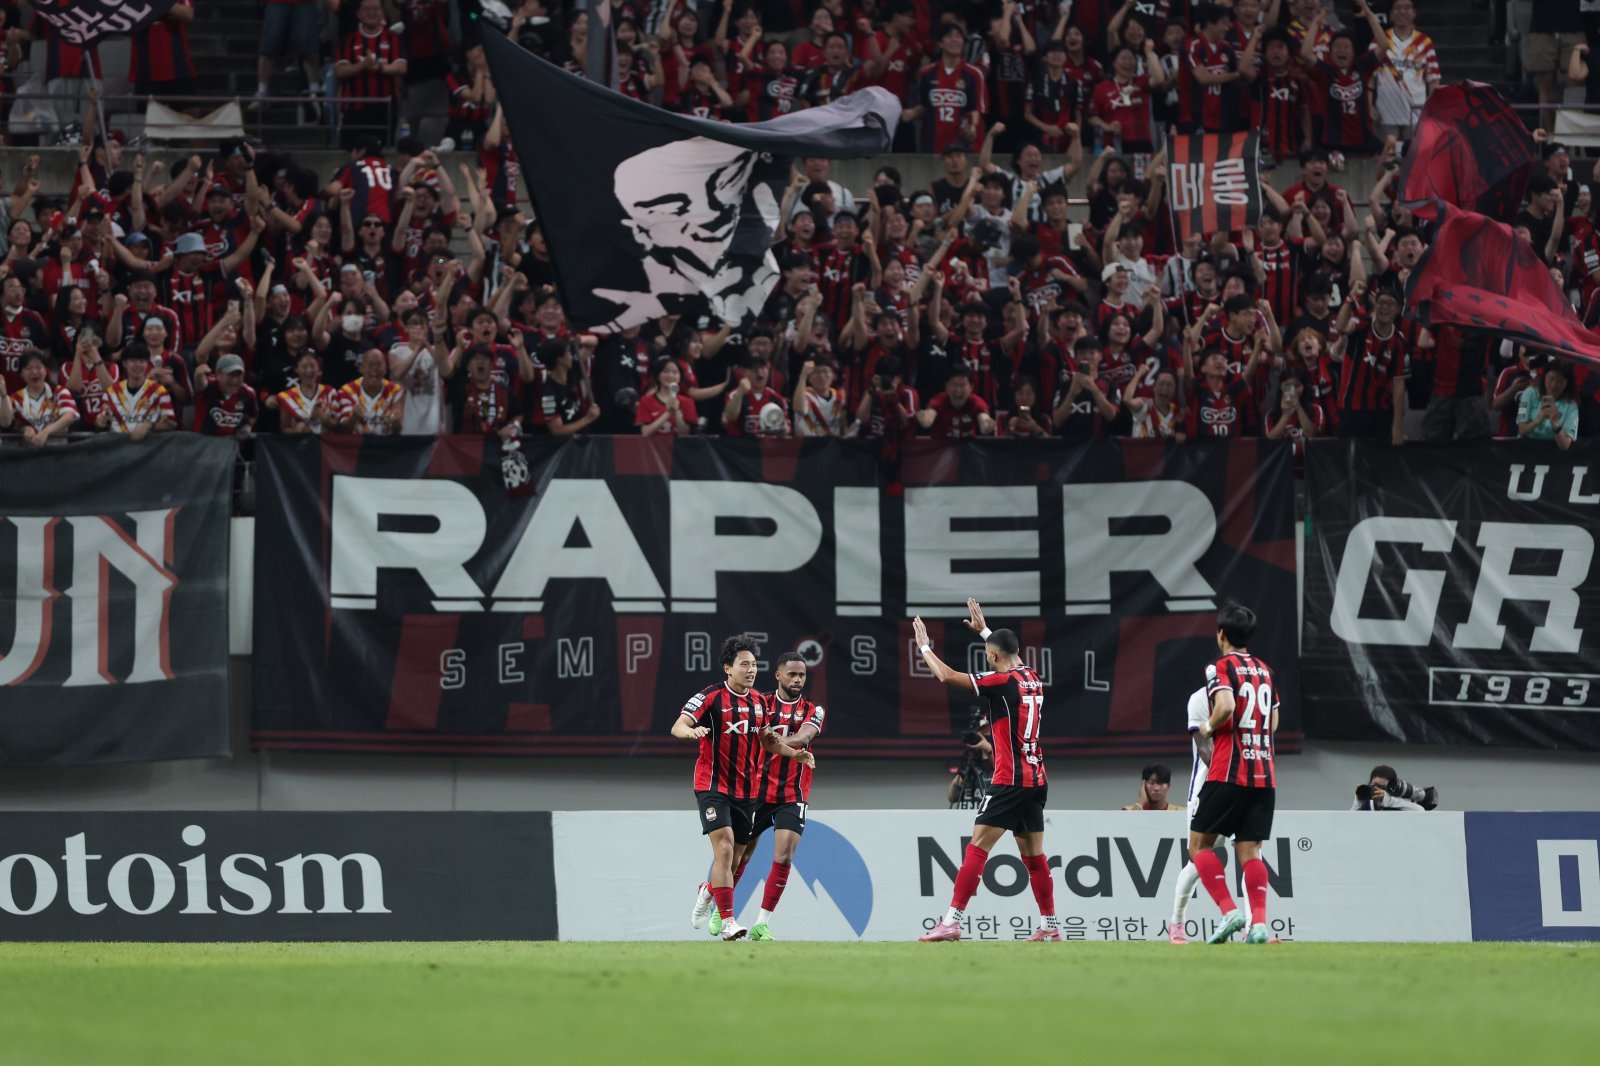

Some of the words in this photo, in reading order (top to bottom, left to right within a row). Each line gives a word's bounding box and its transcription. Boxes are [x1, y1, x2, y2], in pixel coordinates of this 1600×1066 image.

[939, 106, 955, 122] 12
[360, 164, 394, 191] 10
[85, 397, 101, 414] 12
[330, 474, 1217, 617] RAPIER
[1330, 516, 1595, 654] GR
[1238, 681, 1272, 730] 29
[1456, 673, 1591, 706] 1983
[1021, 695, 1044, 739] 77
[0, 825, 392, 916] otoism
[917, 836, 1294, 899] NodVN
[1096, 916, 1148, 941] 위한
